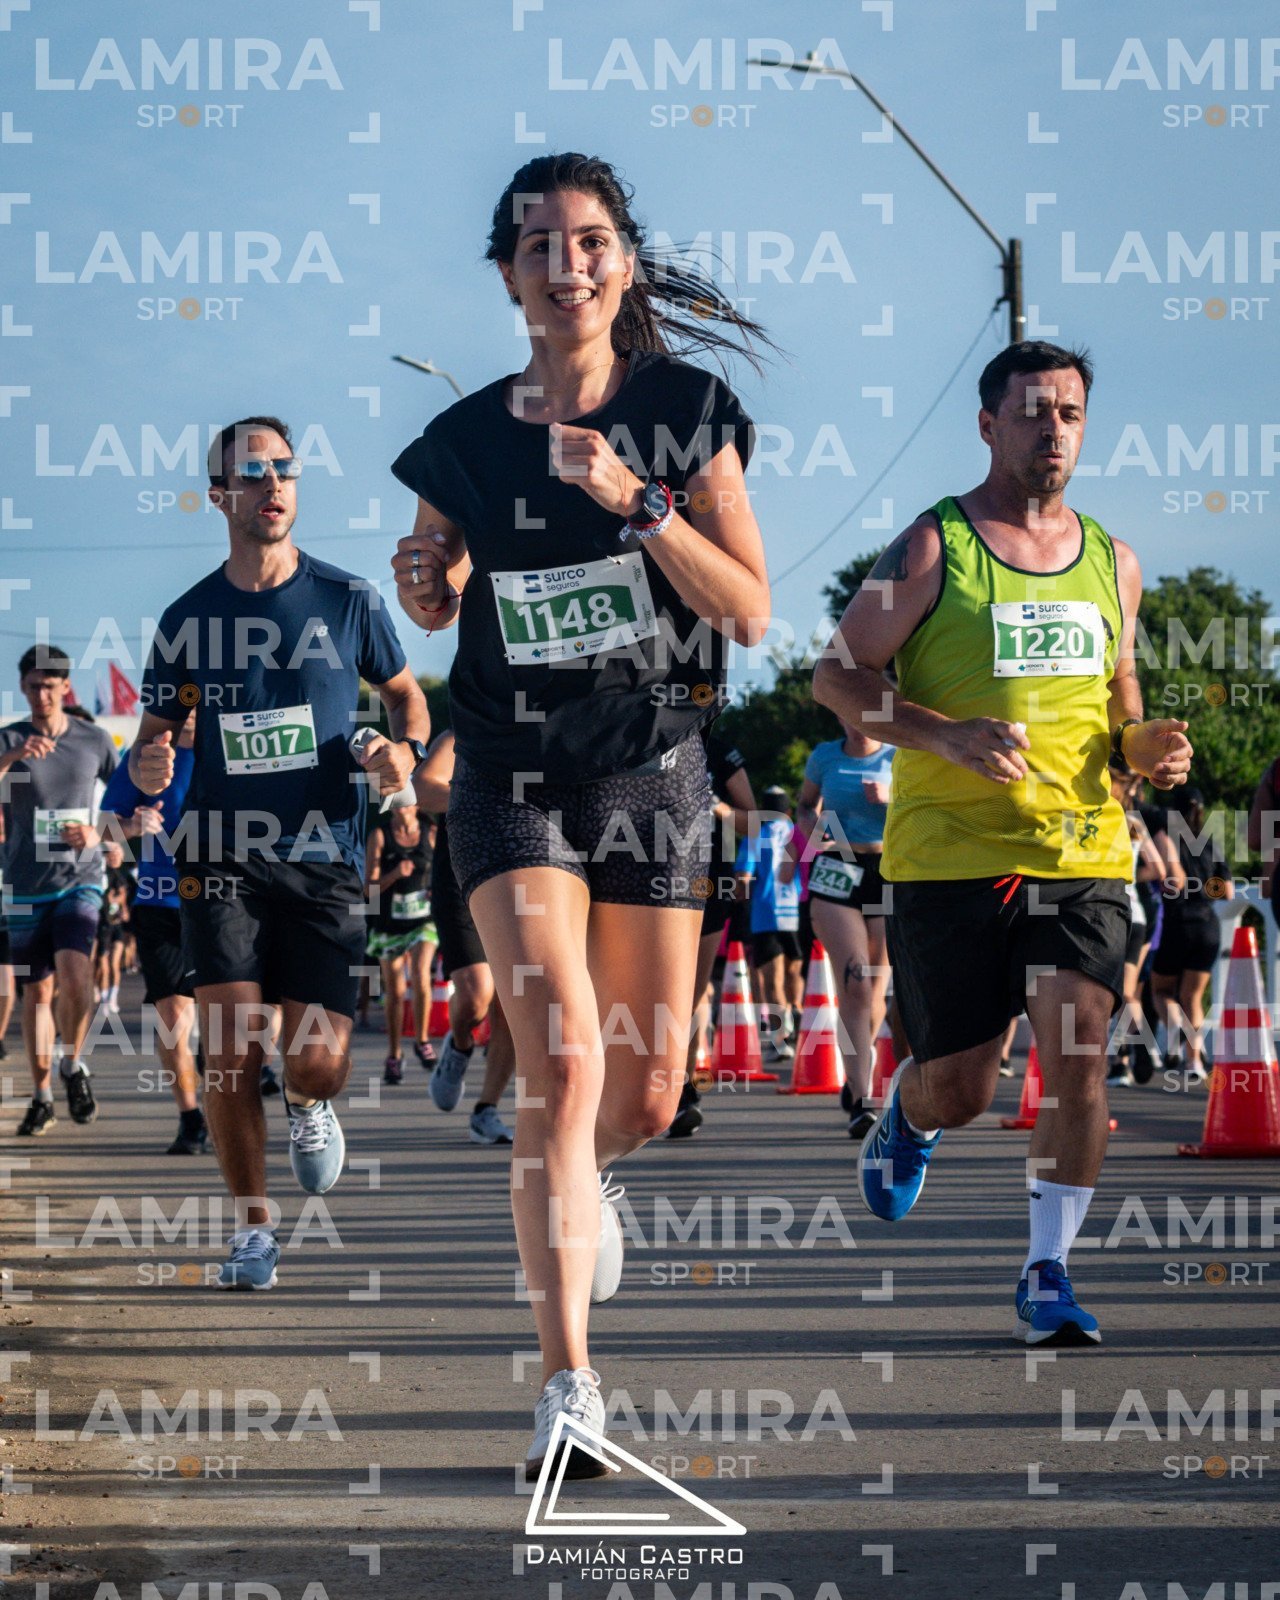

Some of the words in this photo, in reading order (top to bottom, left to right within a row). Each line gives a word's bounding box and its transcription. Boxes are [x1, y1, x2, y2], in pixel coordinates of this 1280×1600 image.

[545, 567, 586, 583] surco
[546, 580, 580, 592] seguros
[1038, 603, 1068, 613] surco
[516, 592, 616, 641] 1148
[1010, 627, 1085, 658] 1220
[256, 711, 285, 721] surco
[235, 728, 300, 759] 1017
